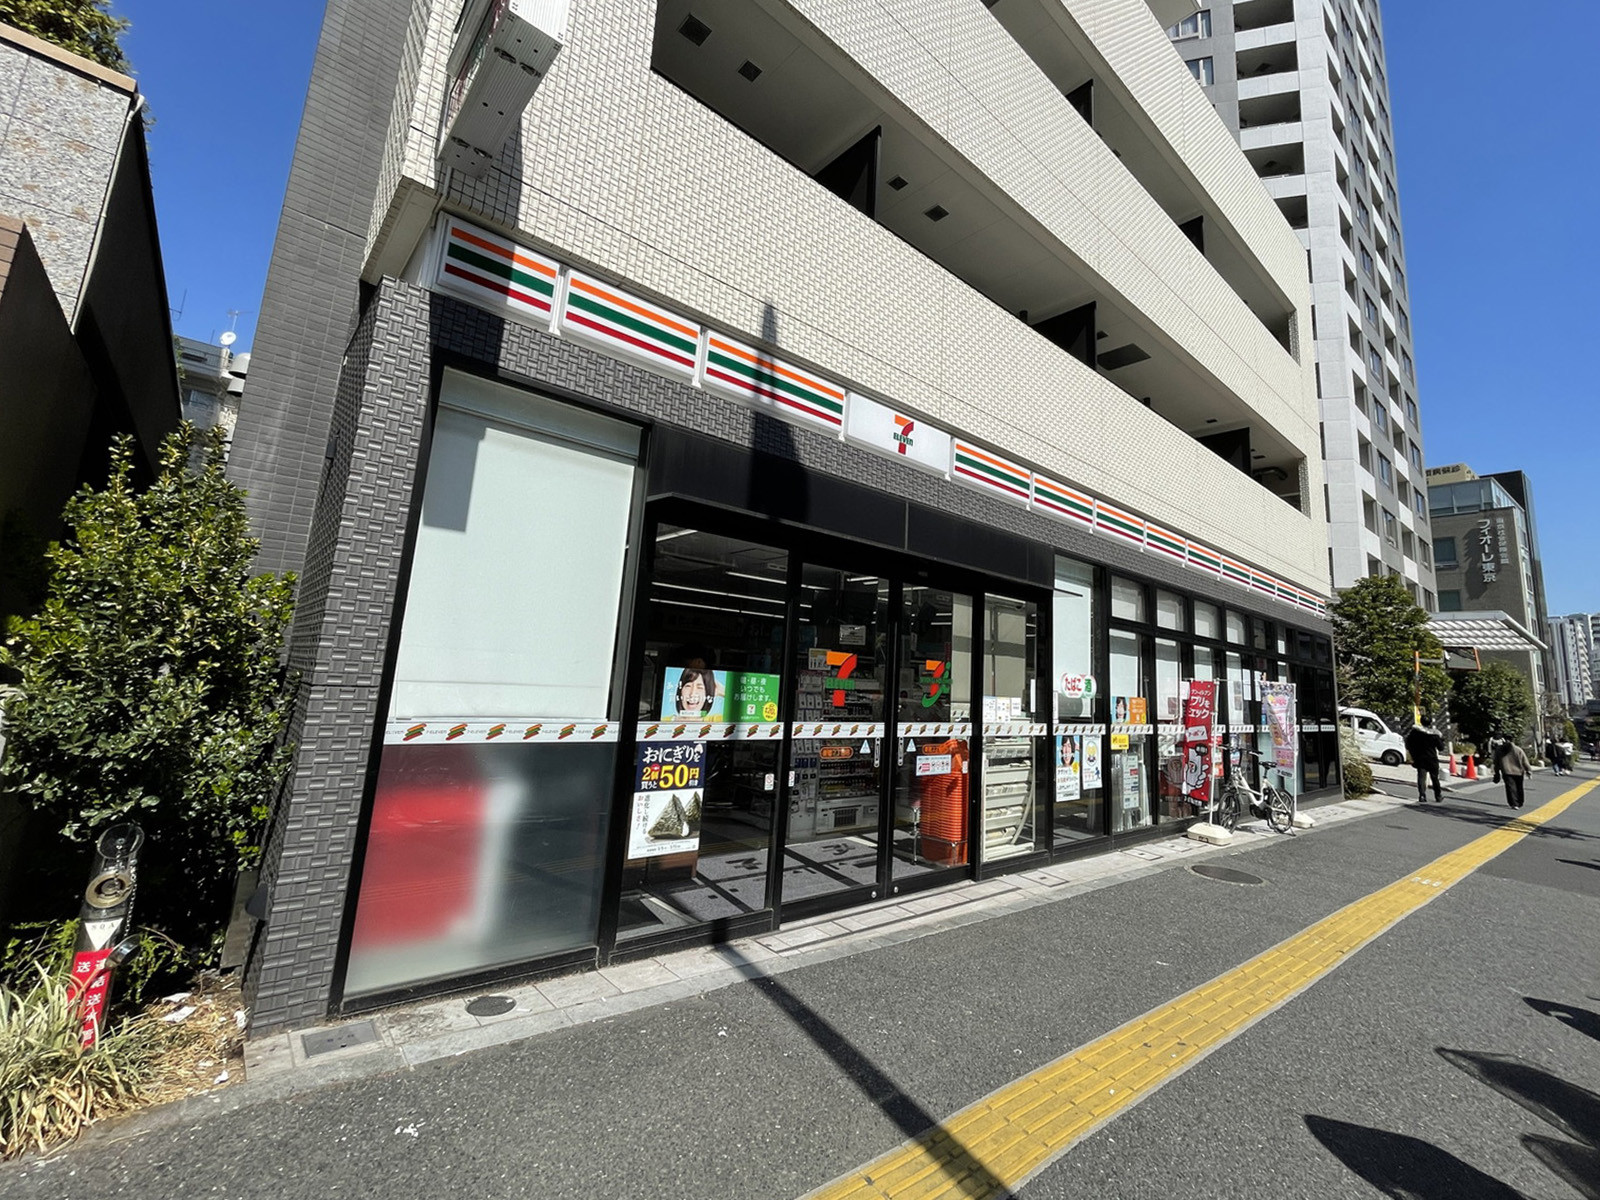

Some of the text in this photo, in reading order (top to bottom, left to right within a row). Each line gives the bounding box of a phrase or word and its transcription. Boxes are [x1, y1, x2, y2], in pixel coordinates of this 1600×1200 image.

[894, 414, 914, 455] 7
[1479, 519, 1497, 583] フィオーレ東京
[740, 685, 766, 694] いつでも
[1064, 676, 1092, 693] たばこ 酒
[1188, 708, 1210, 719] ェック
[643, 746, 701, 763] おにぎりを
[640, 781, 658, 790] 買うと
